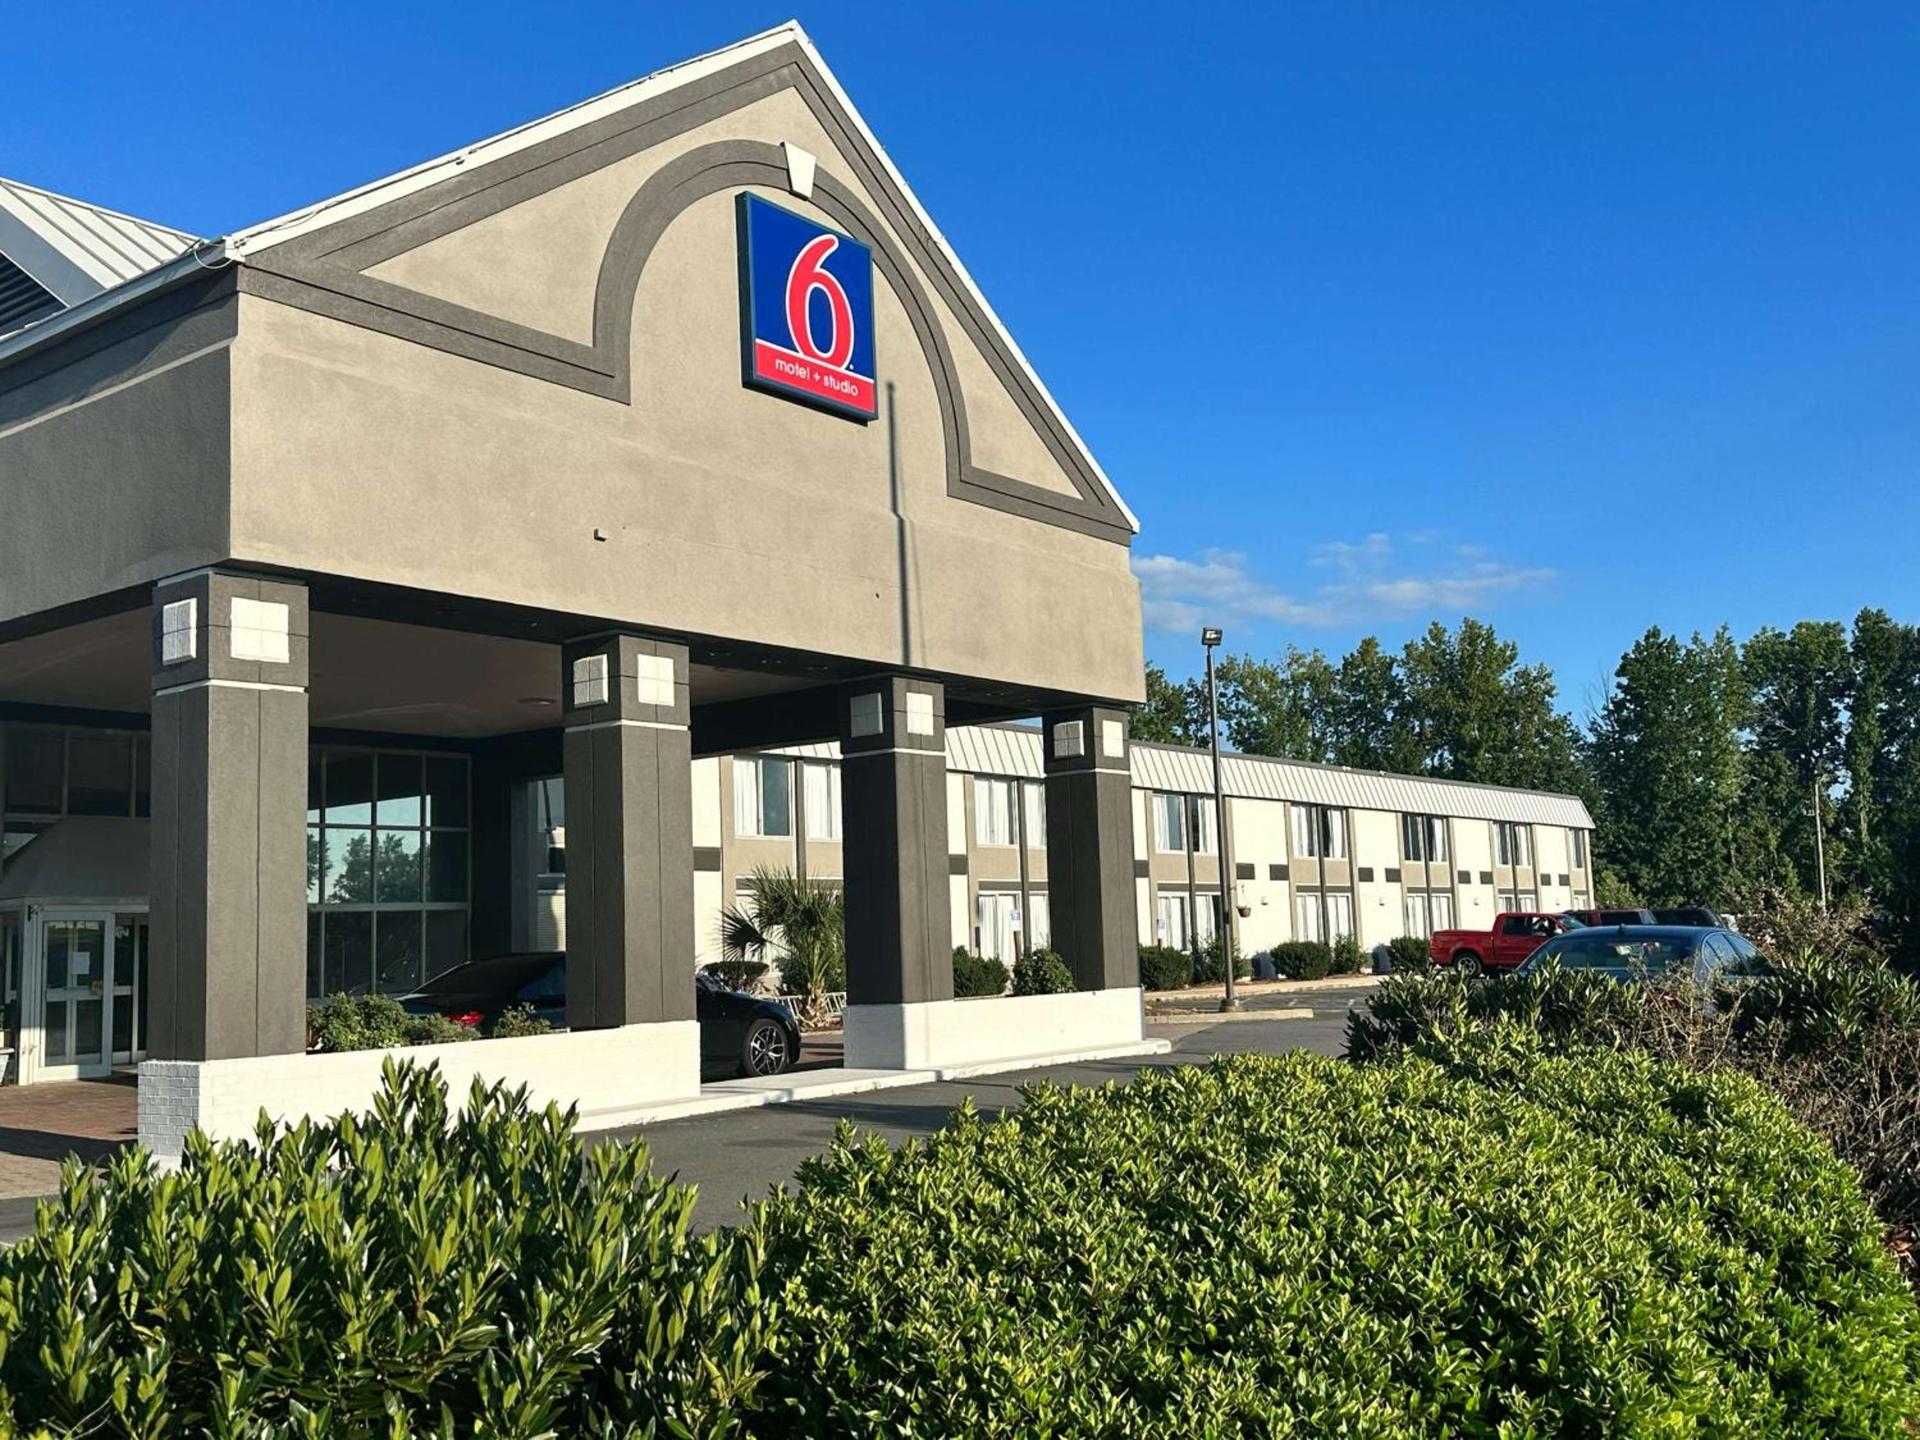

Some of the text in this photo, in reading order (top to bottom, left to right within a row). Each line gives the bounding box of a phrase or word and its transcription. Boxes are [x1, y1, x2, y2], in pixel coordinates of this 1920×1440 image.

[786, 234, 854, 370] 6
[775, 359, 810, 380] motel
[823, 375, 859, 397] studio
